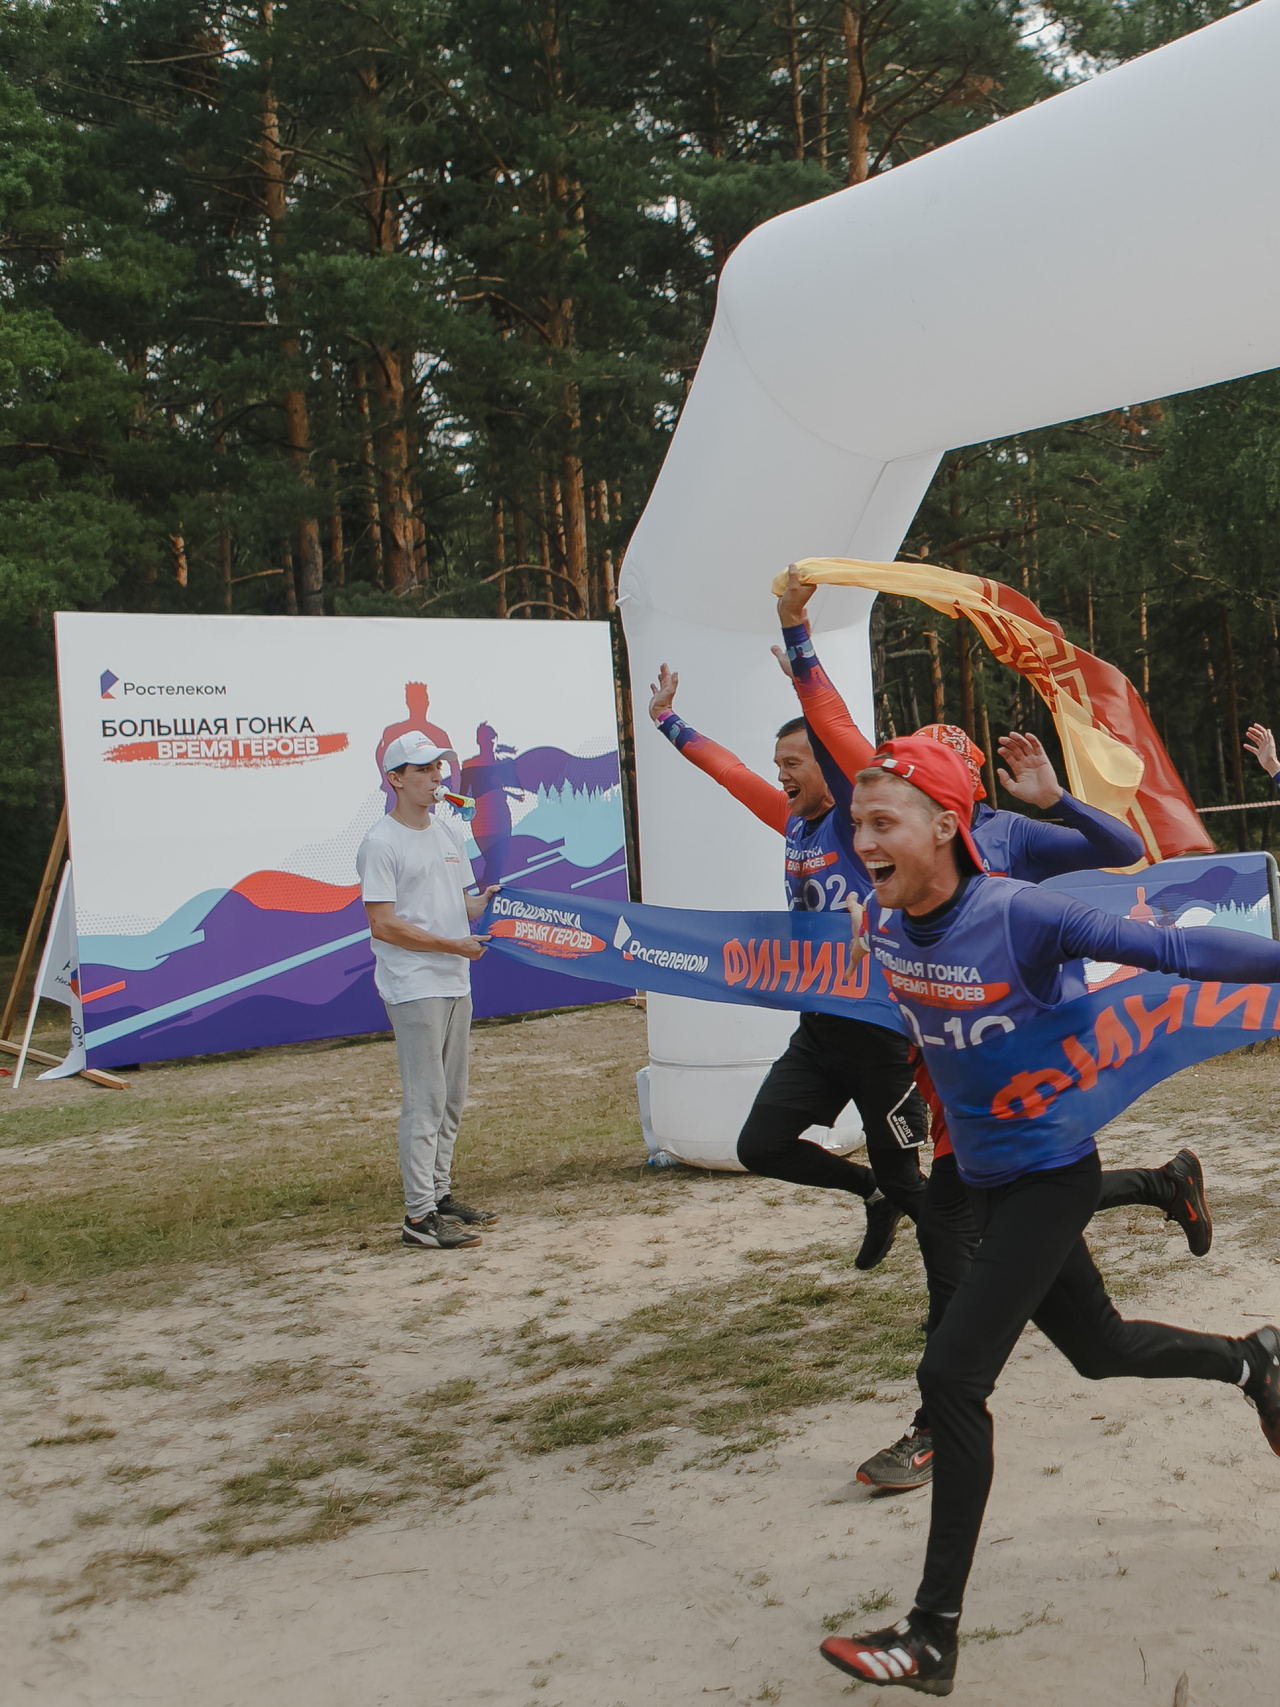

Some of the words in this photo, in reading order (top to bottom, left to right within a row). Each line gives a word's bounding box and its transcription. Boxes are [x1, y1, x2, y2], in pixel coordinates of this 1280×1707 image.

[123, 682, 227, 696] Ростелеком
[101, 718, 229, 738] БОЛЬШАЯ
[236, 716, 315, 734] ГОНКА
[157, 741, 234, 760] ВРЕМЯ
[238, 738, 320, 756] ГЕРОЕВ
[514, 921, 551, 943] ВРЕМЯ
[549, 926, 593, 950] ГЕРОЕВ
[629, 939, 709, 973] Ростелеком
[722, 937, 871, 999] ФИНИШ
[926, 963, 982, 984] ГОНКА
[891, 974, 929, 995] ВРЕМЯ
[930, 982, 986, 1002] ГЕРОЕВ
[897, 1115, 914, 1138] SPORT
